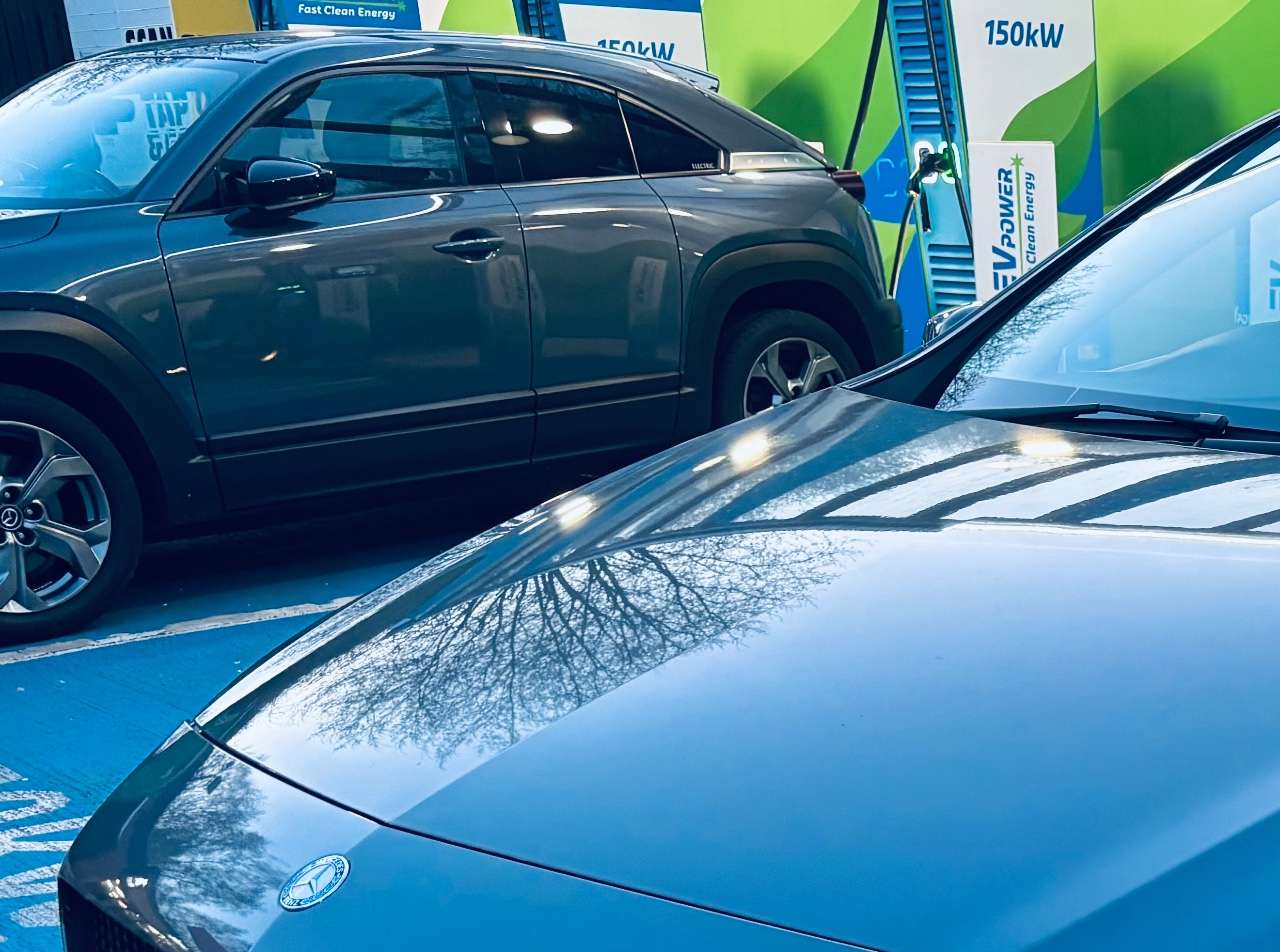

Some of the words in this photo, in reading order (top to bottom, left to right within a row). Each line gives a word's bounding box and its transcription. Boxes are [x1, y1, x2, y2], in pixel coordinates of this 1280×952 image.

[298, 4, 322, 15] Fast
[324, 6, 355, 17] Clean
[358, 8, 397, 21] Energy
[984, 19, 1065, 49] 150kW
[1024, 172, 1036, 222] Energy
[1025, 225, 1037, 265] Clean
